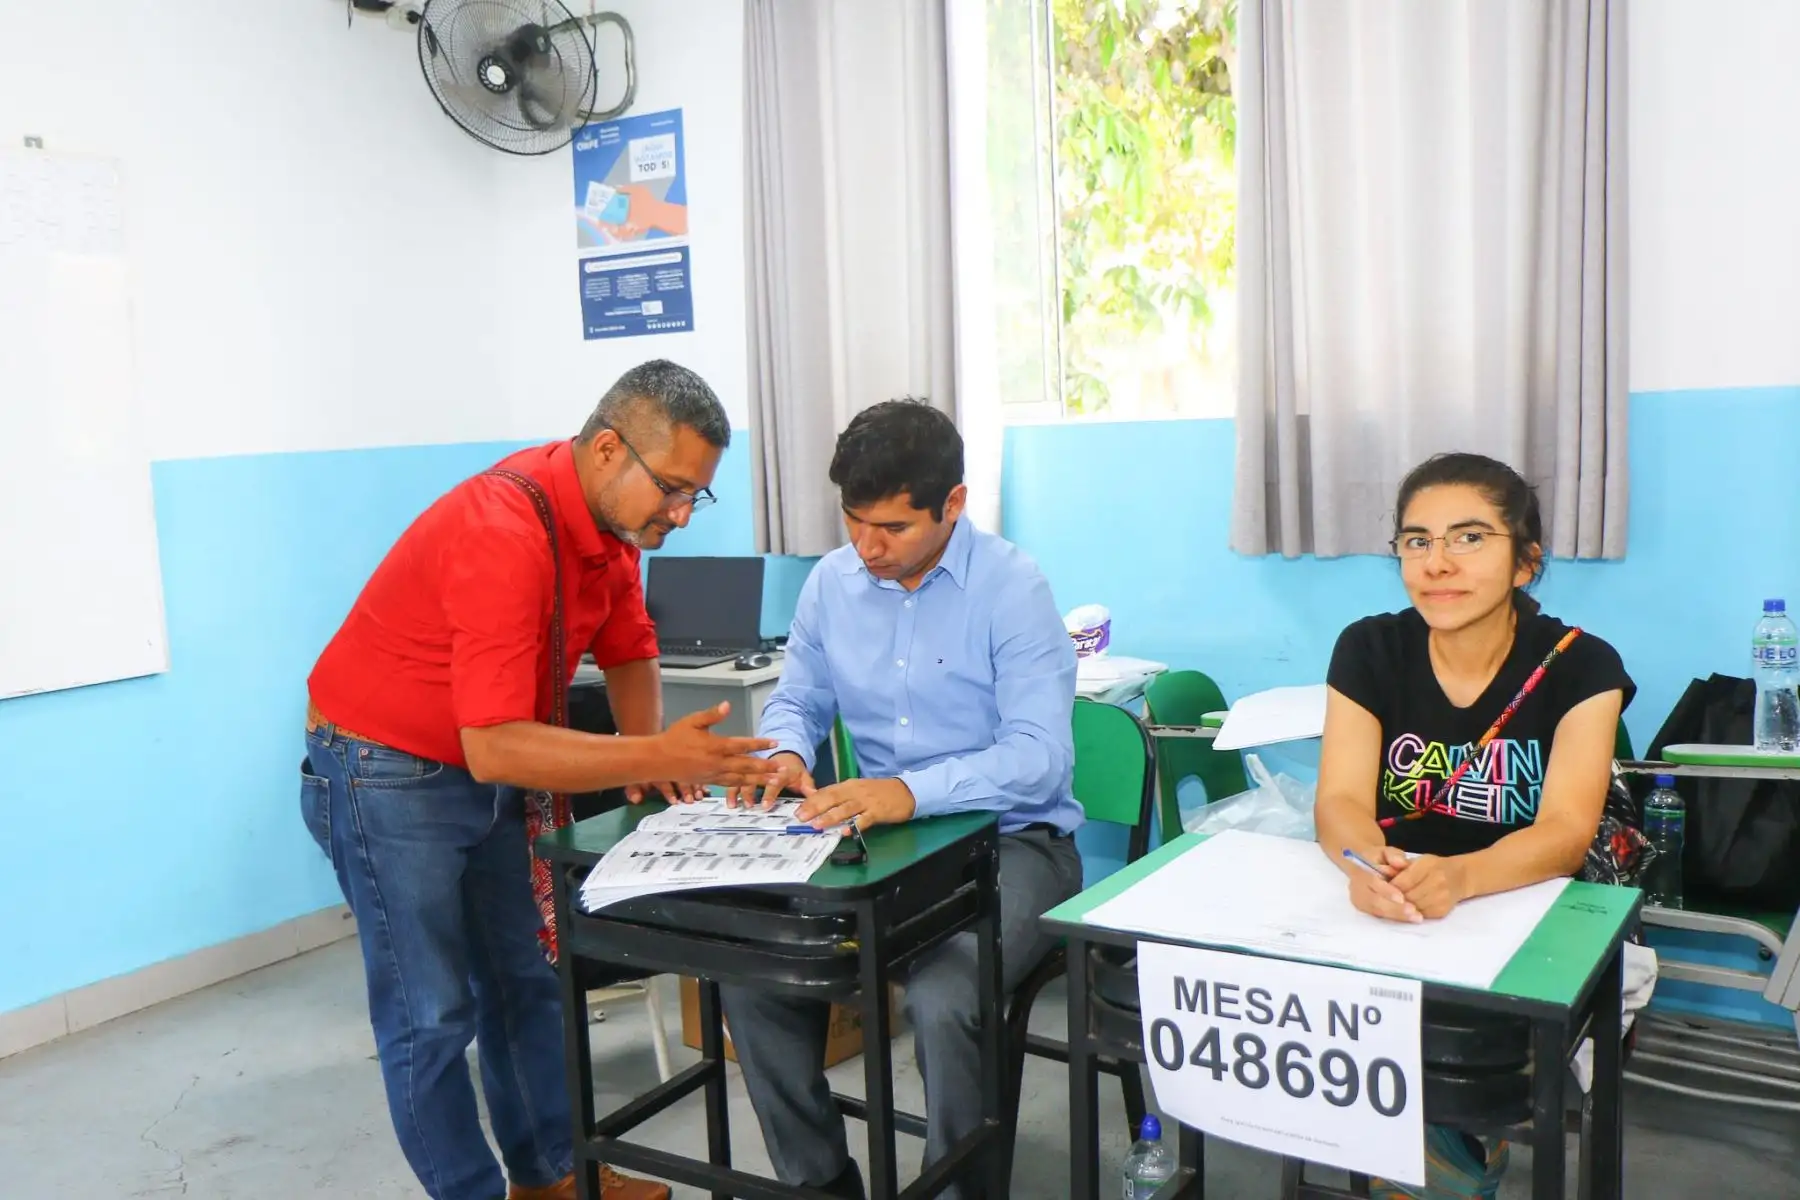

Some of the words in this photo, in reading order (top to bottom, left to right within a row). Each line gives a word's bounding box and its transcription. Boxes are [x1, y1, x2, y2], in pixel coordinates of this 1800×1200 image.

[1753, 647, 1796, 660] CIELO
[1388, 733, 1542, 784] CALVIN
[1384, 769, 1542, 824] KLEIN
[1173, 975, 1312, 1033] MESA
[1150, 1017, 1407, 1118] 048690
